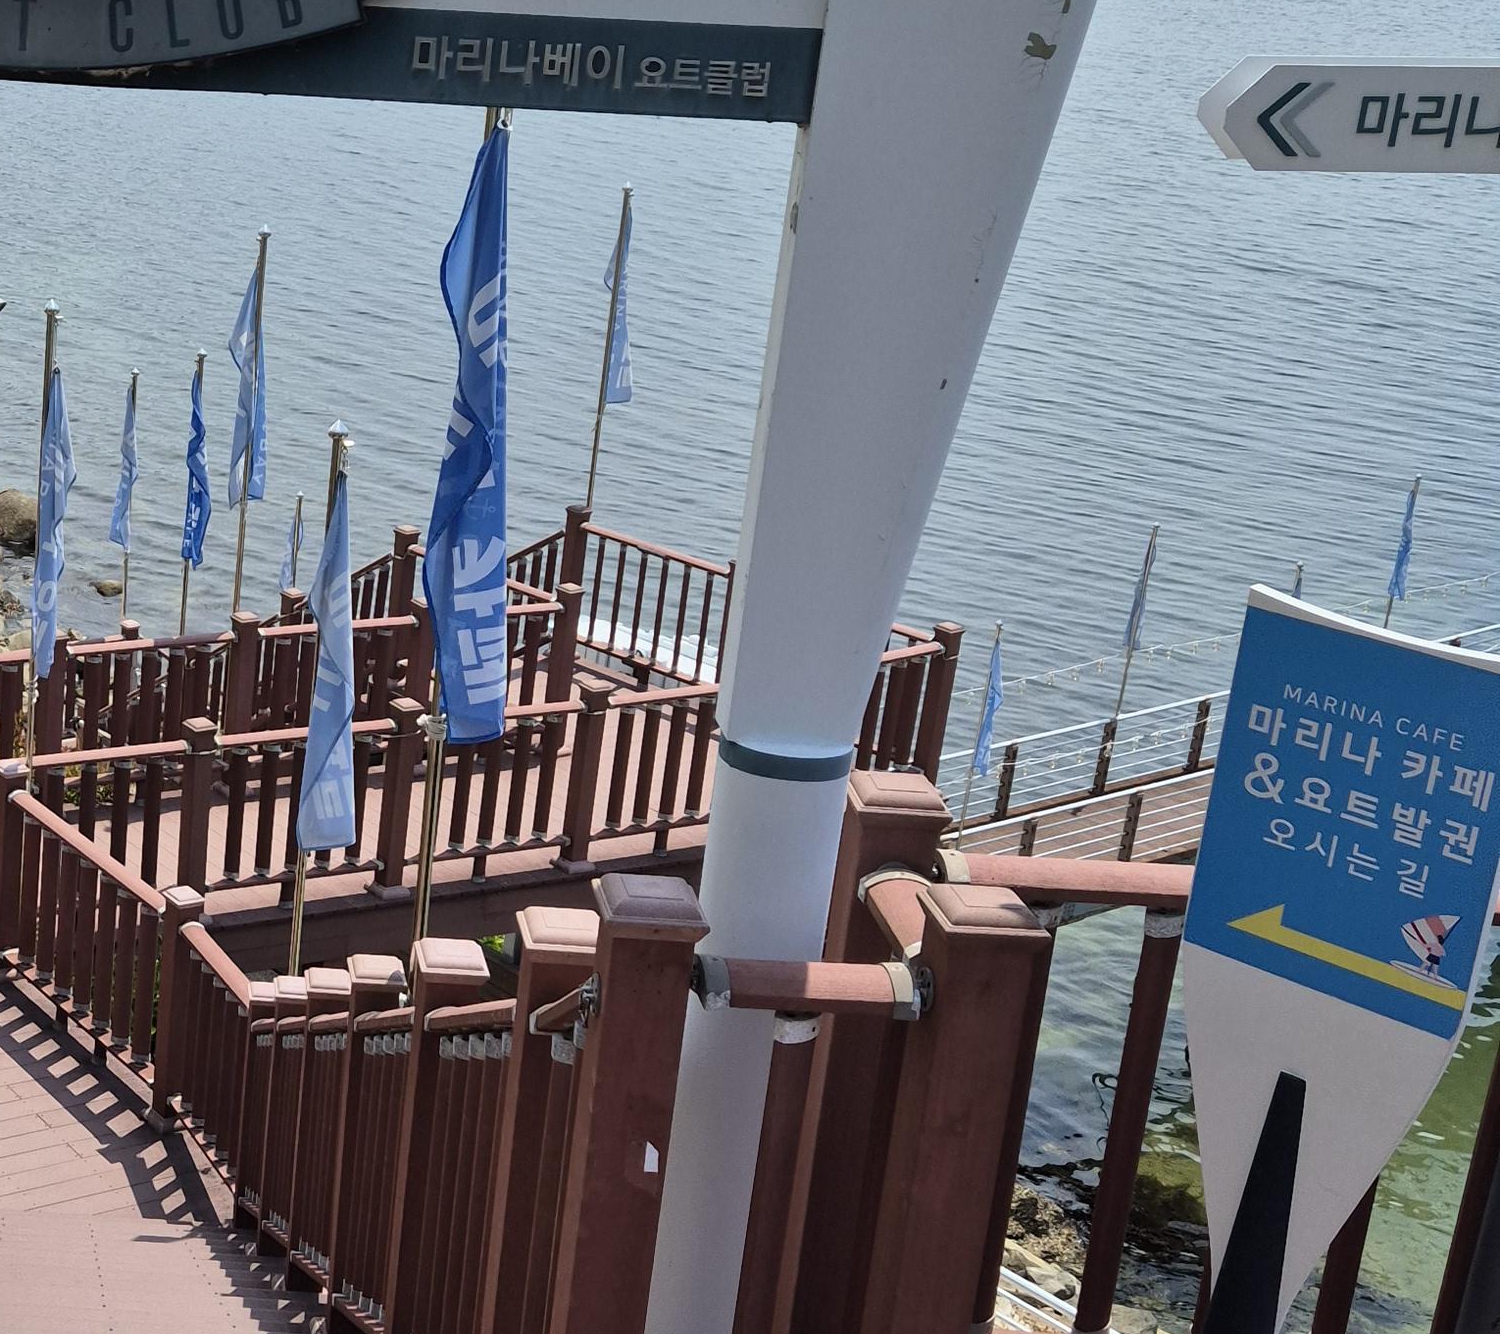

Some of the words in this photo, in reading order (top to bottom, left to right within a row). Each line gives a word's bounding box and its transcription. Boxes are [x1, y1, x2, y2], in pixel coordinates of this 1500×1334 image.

[411, 34, 625, 89] 마리나베이
[635, 56, 771, 98] 요트클럽
[1283, 683, 1384, 729] MARINA
[1395, 717, 1466, 752] CAFE
[1247, 703, 1382, 777] 마리나
[1401, 750, 1495, 813] 카페
[1262, 818, 1381, 882] 오시는
[1396, 858, 1429, 899] 길
